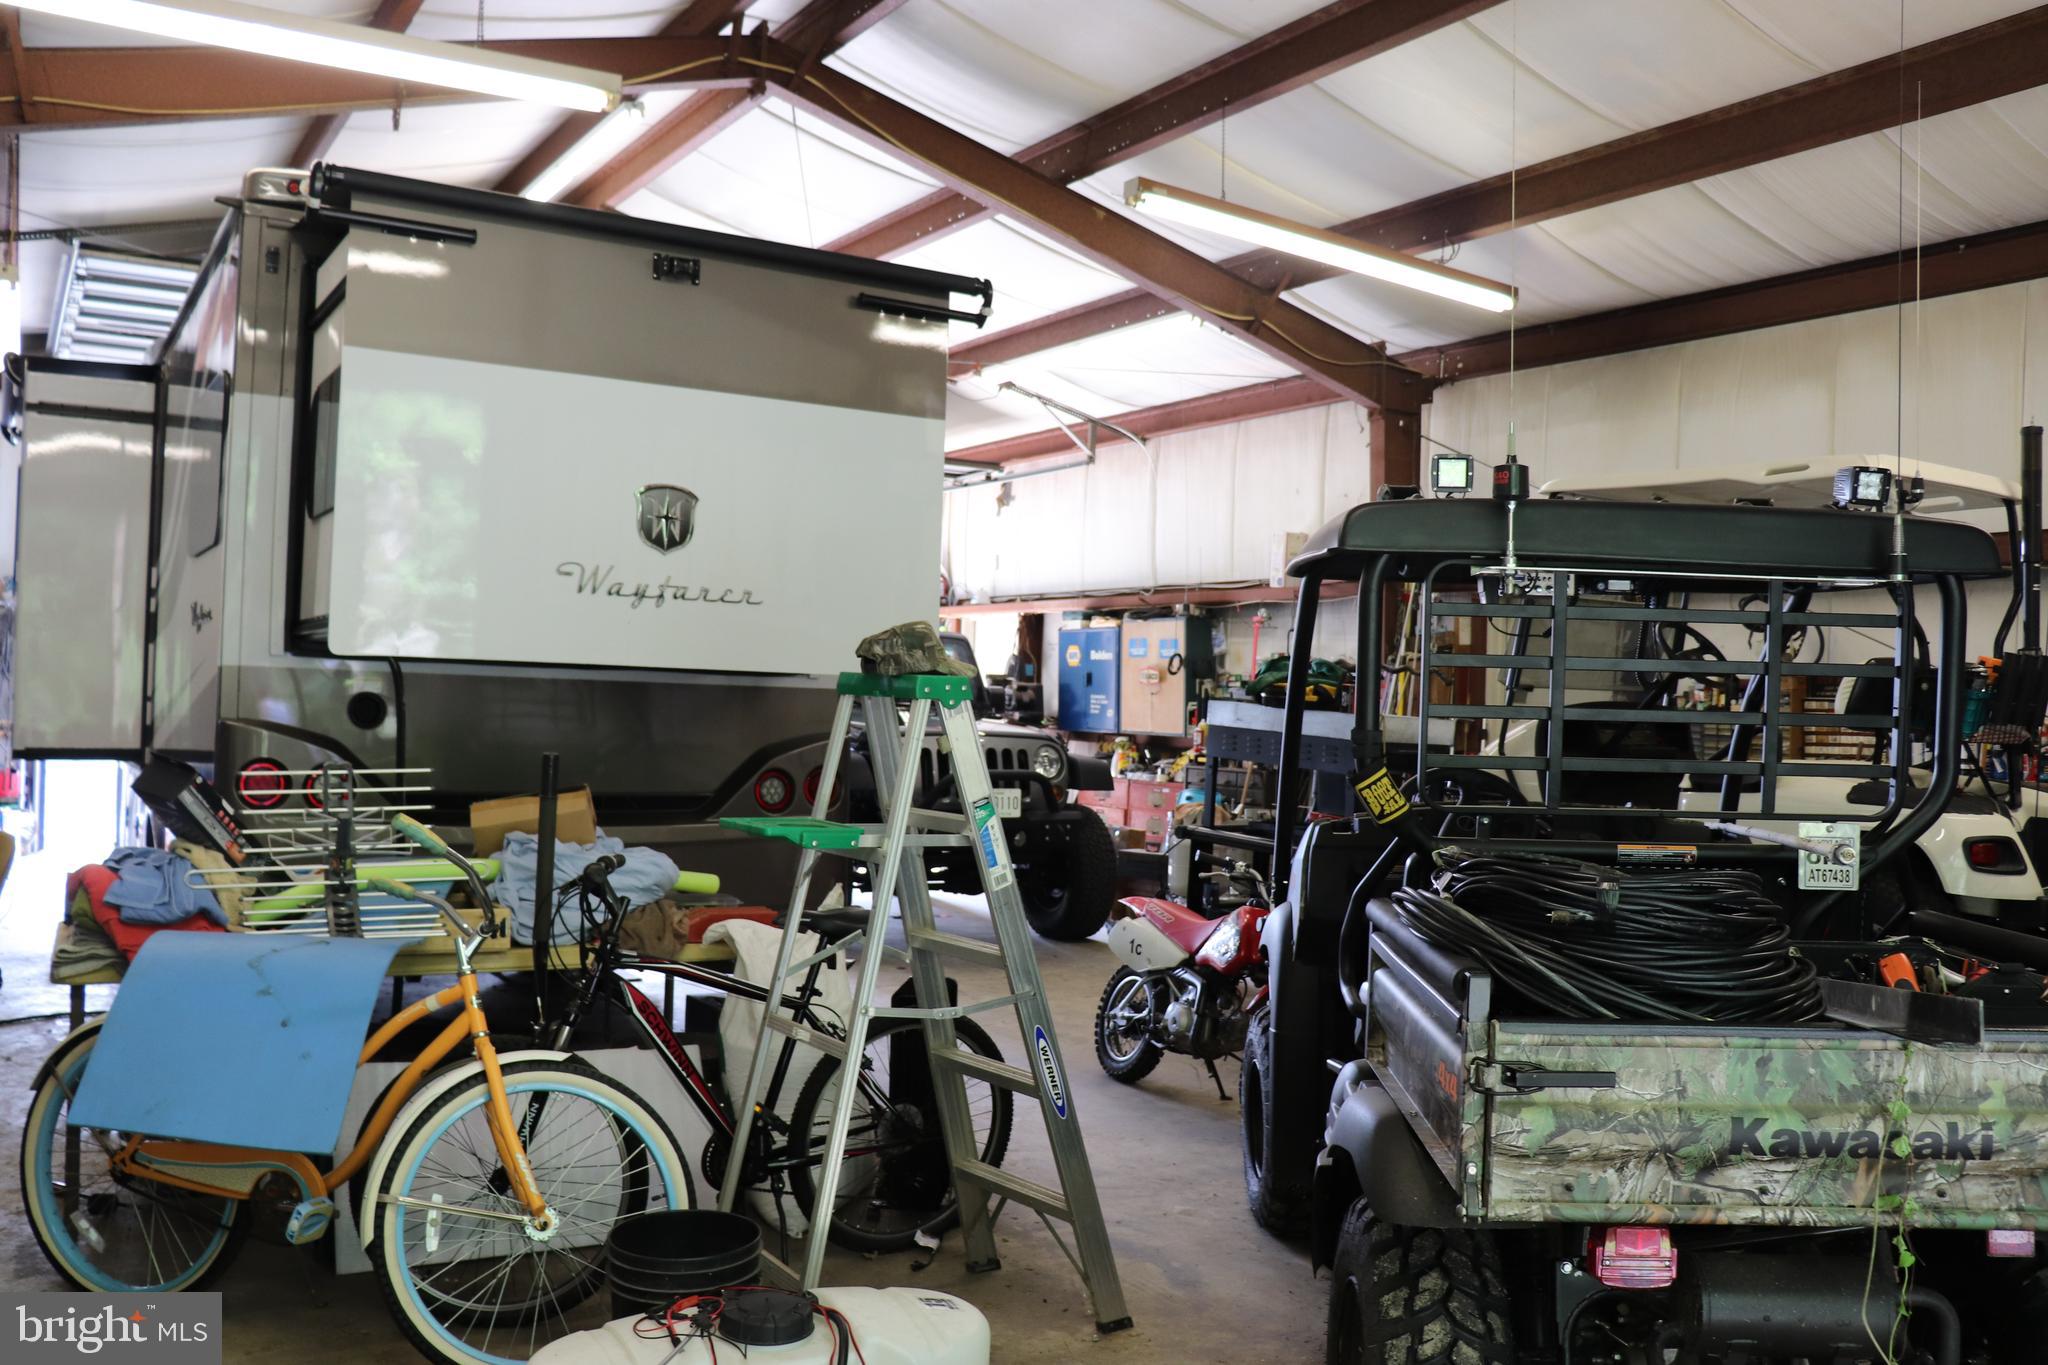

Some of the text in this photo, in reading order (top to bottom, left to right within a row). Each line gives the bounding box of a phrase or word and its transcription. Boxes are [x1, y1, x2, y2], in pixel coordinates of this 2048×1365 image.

[556, 561, 764, 610] Wayfarer
[1808, 868, 1851, 883] AT67438
[1040, 1045, 1062, 1101] WERNER
